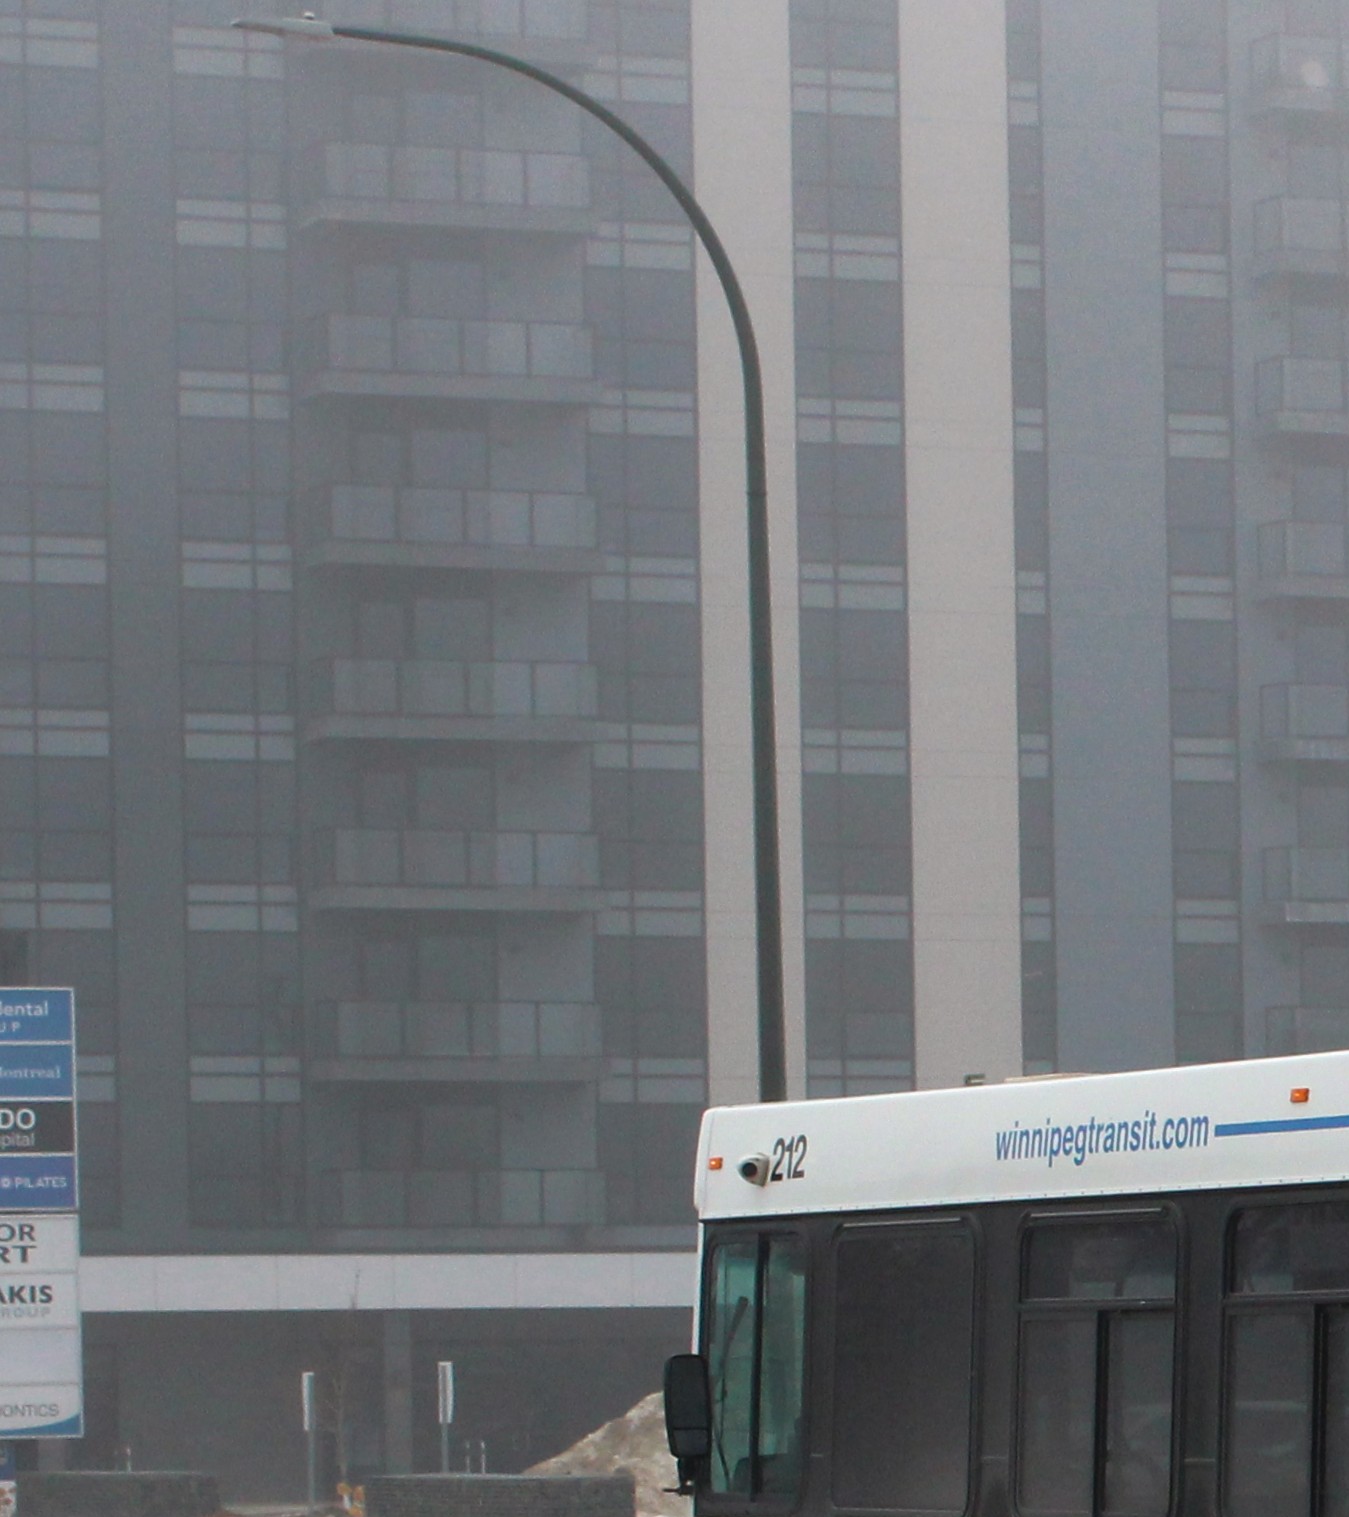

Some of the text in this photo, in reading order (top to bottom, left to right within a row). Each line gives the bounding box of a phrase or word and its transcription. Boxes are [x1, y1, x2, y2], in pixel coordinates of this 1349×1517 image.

[0, 1000, 48, 1016] ental
[0, 1066, 60, 1078] ontreal
[995, 1112, 1209, 1167] winnipegtransit.com
[770, 1134, 808, 1182] 212
[0, 1404, 59, 1417] ONTICS
